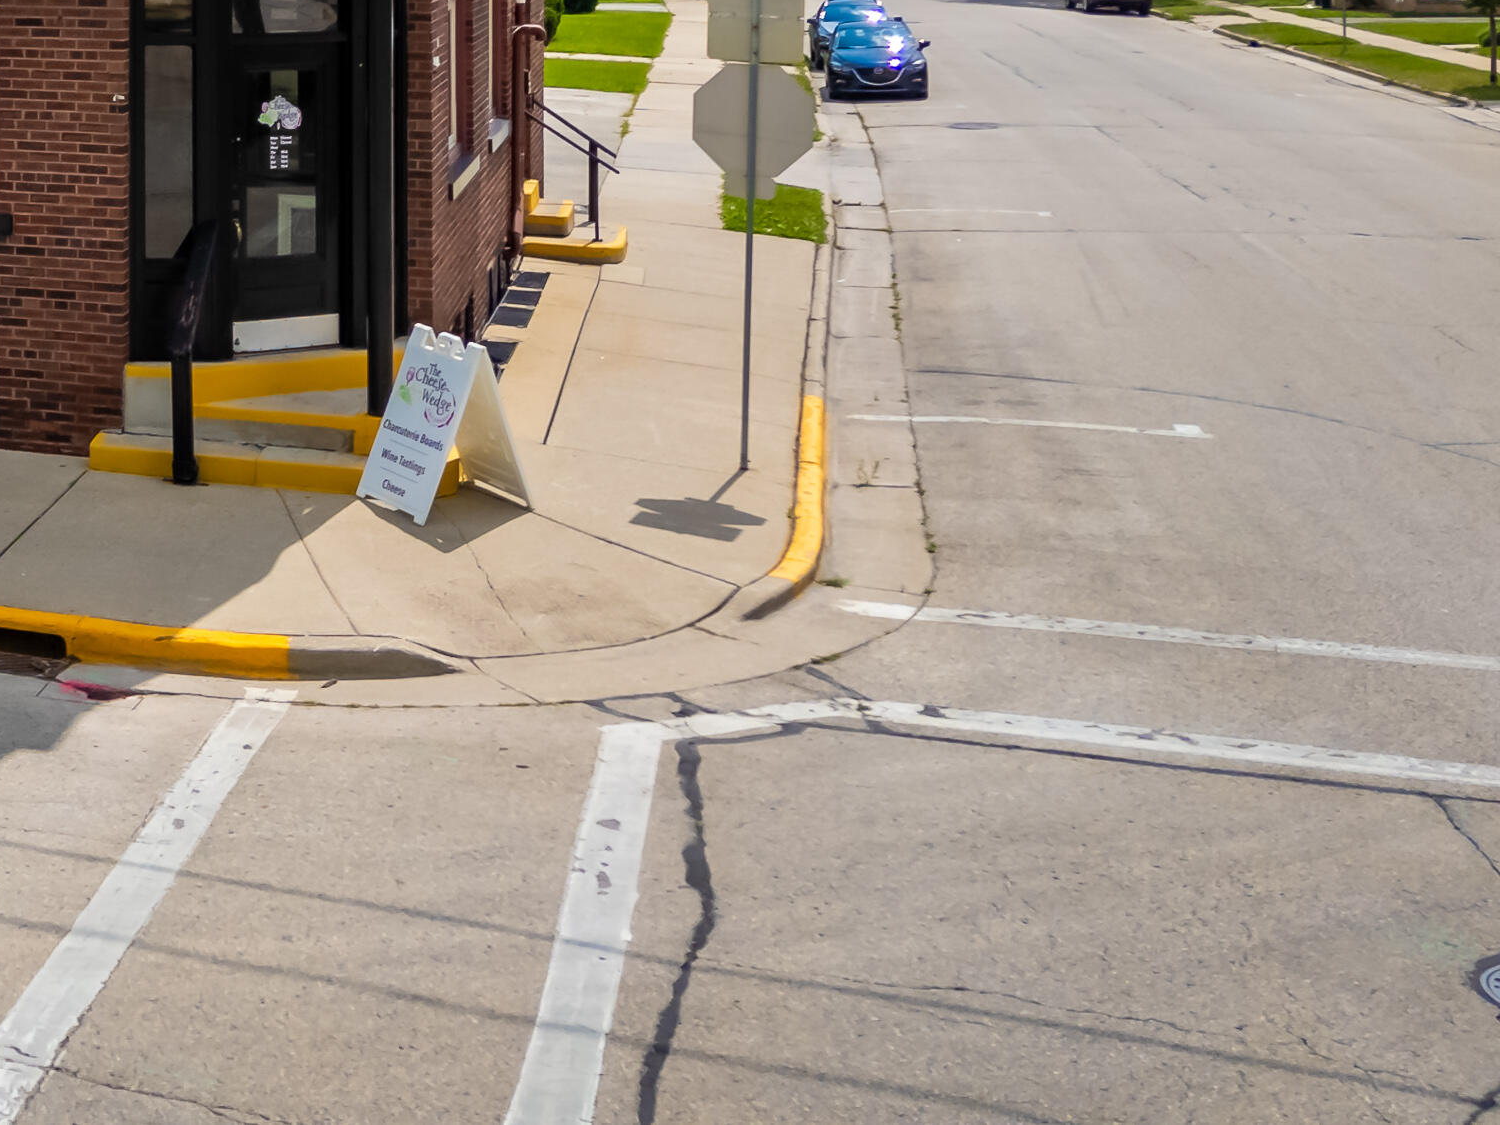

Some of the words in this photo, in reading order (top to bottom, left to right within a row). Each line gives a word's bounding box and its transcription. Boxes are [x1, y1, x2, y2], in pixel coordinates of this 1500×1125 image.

[415, 367, 450, 392] Cheese
[429, 363, 442, 376] The
[422, 388, 452, 416] Wedge
[383, 418, 420, 441] Charcuterie
[420, 433, 444, 451] Boards
[381, 447, 399, 463] Wine
[399, 455, 426, 476] Tastings
[382, 479, 406, 497] Cheese
